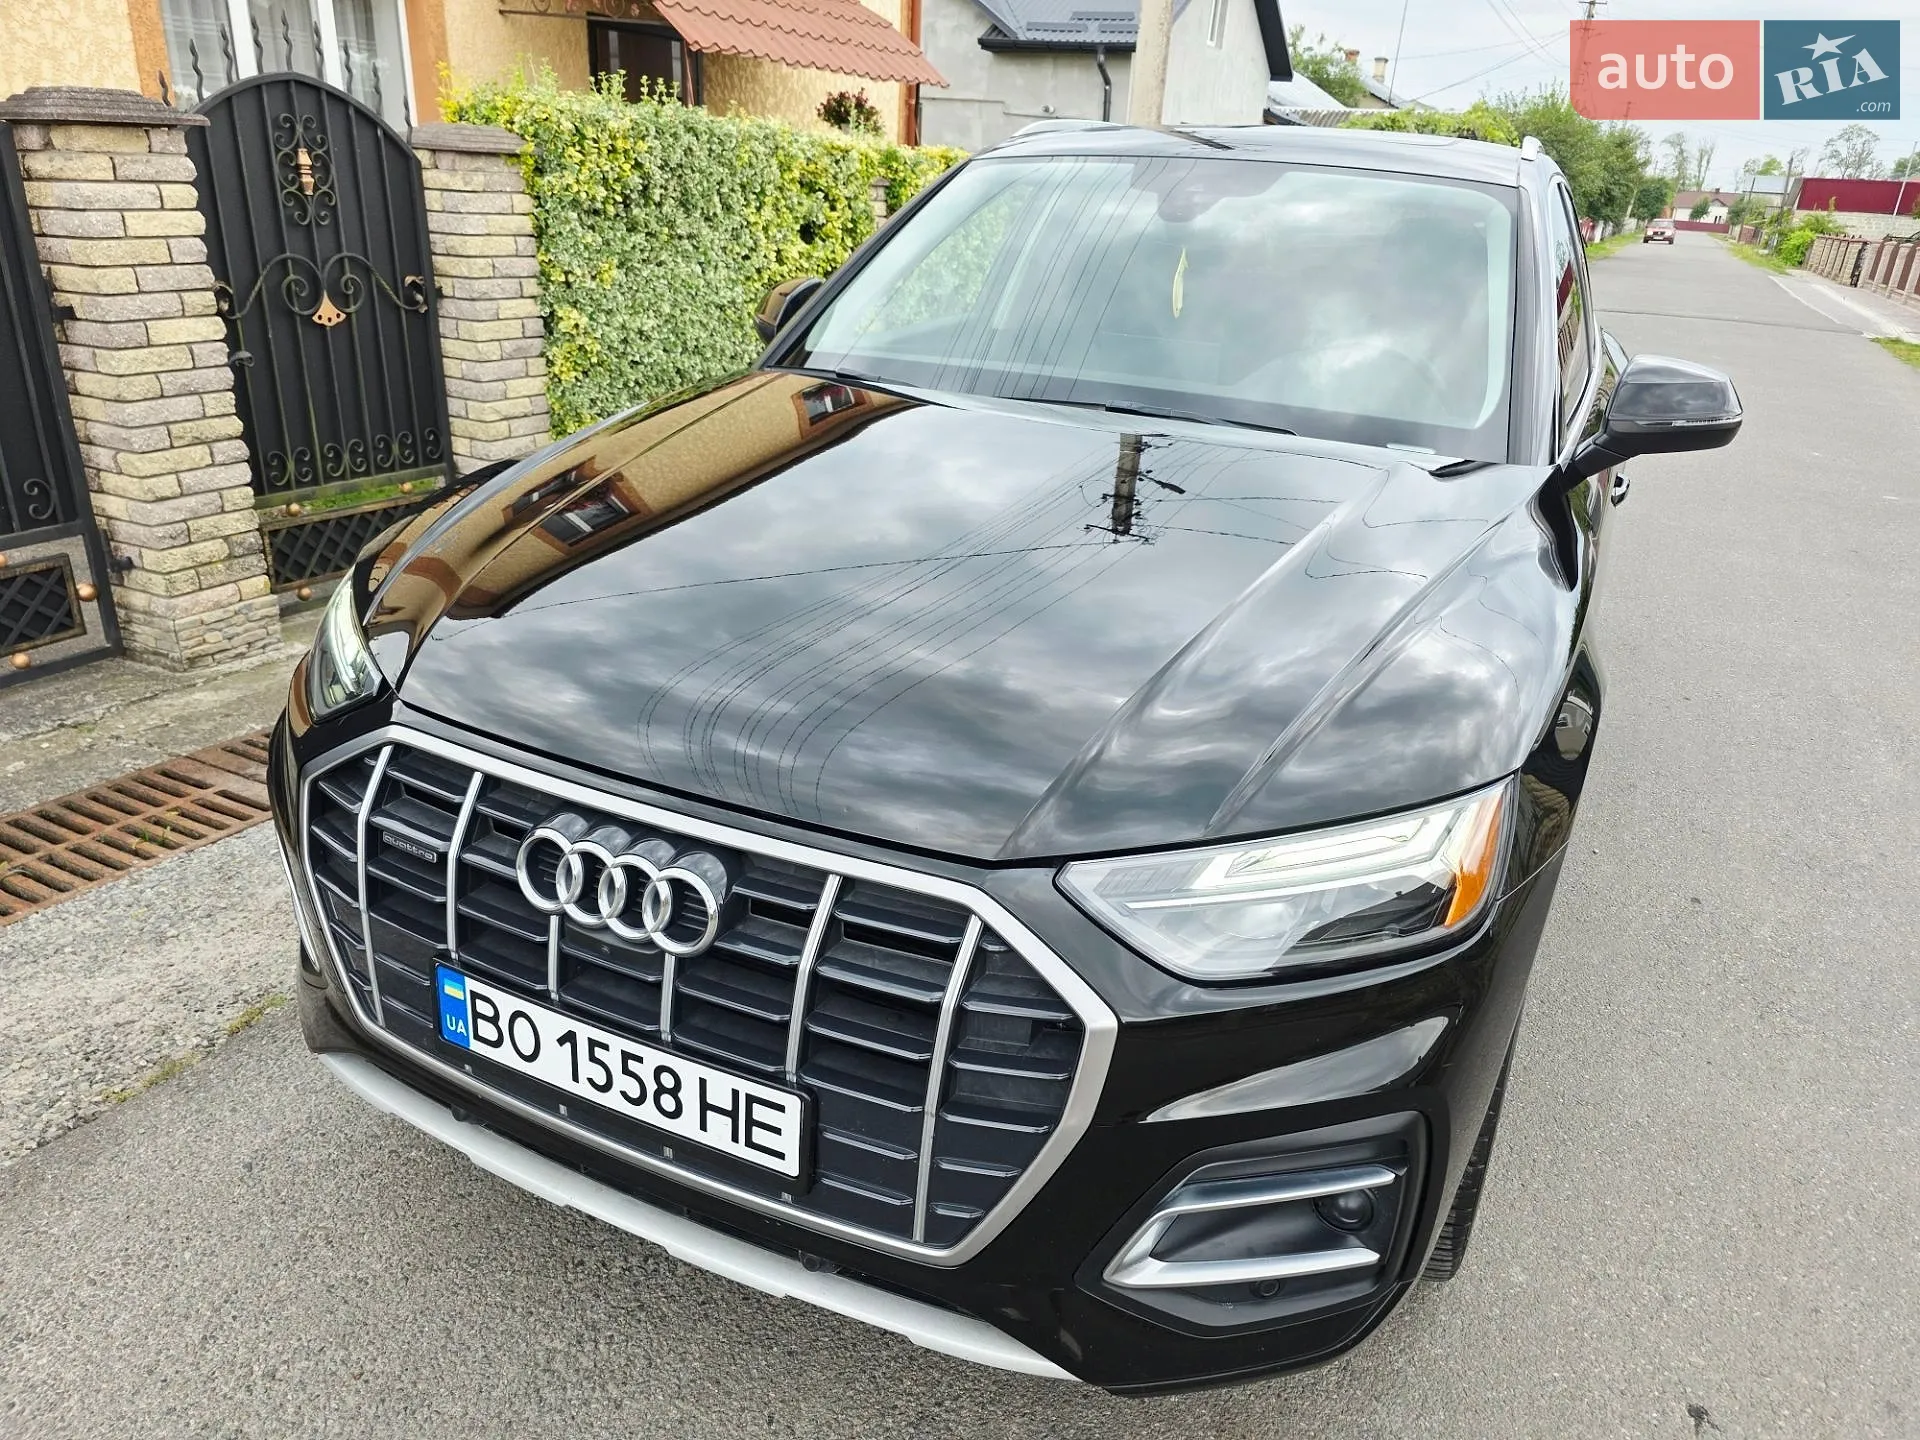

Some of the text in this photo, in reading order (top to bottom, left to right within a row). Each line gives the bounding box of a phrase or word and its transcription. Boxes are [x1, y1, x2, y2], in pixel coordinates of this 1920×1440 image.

[383, 835, 433, 860] quattro
[446, 1014, 468, 1037] UA
[469, 989, 786, 1161] BO 1558 HE
